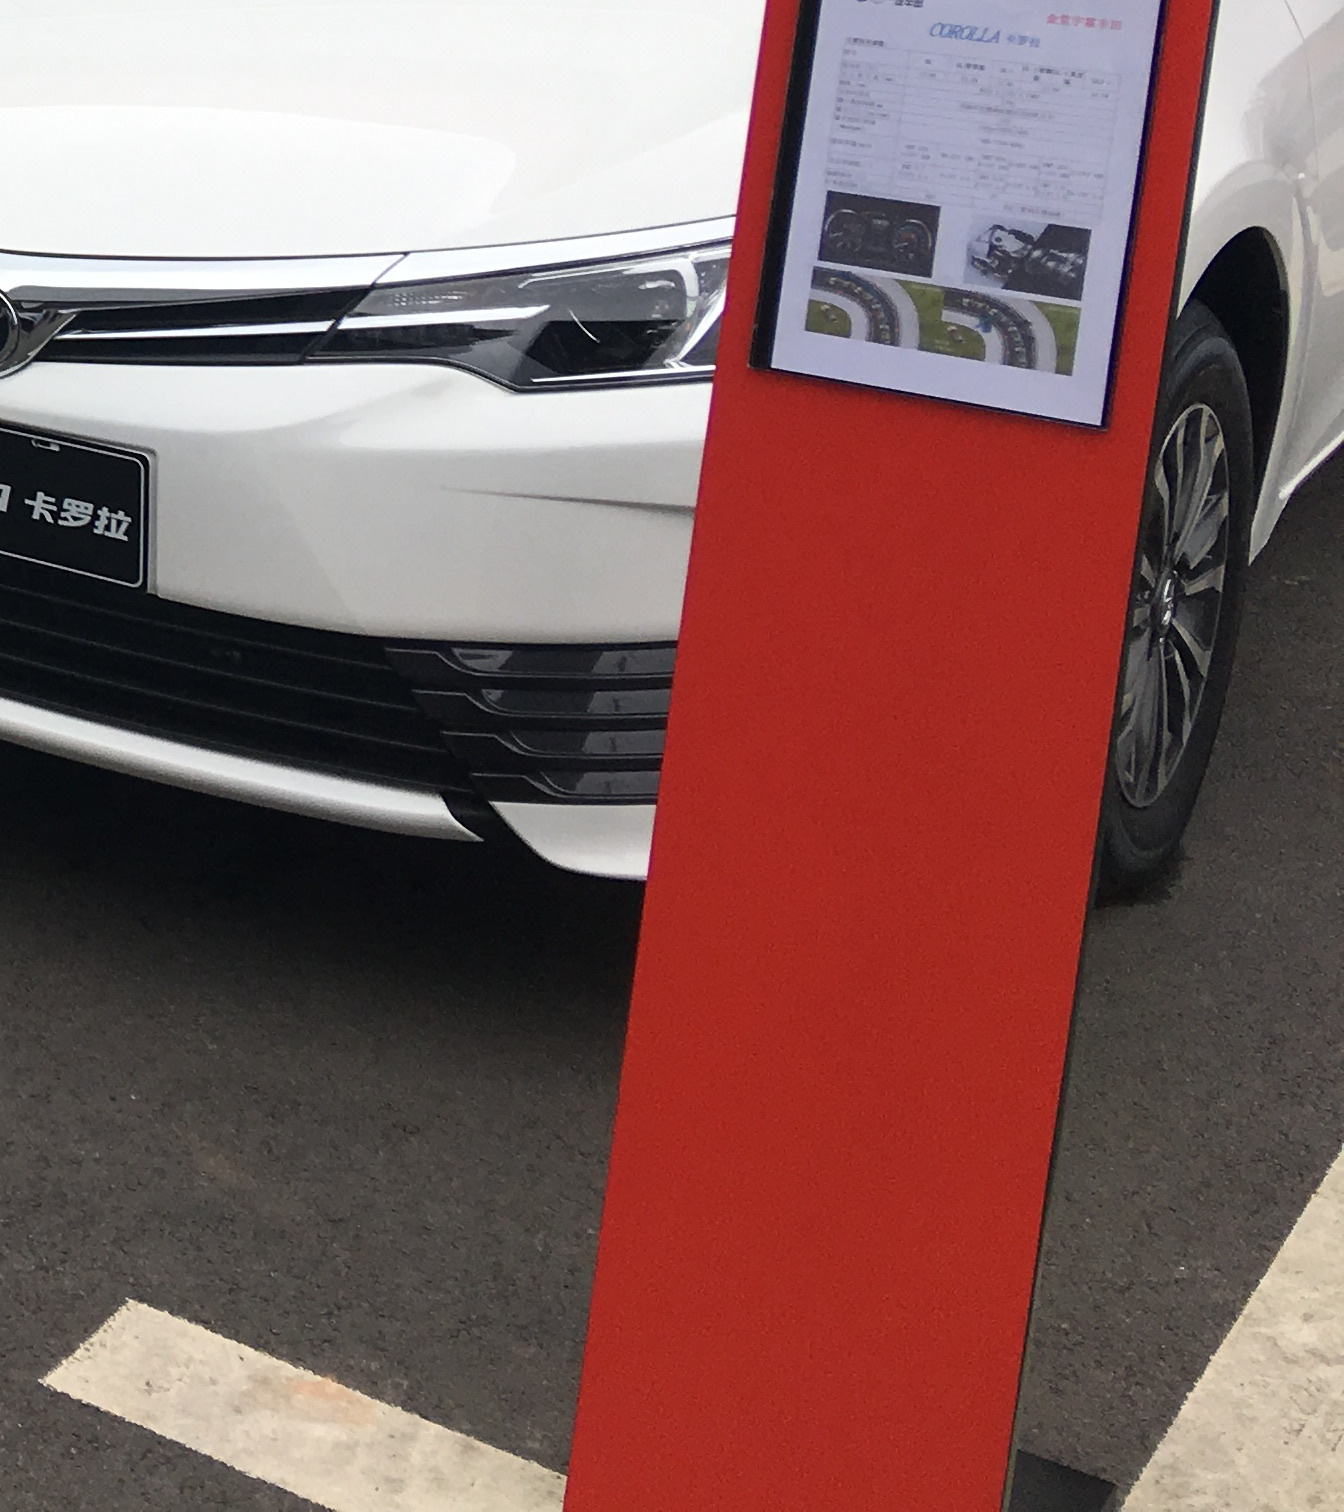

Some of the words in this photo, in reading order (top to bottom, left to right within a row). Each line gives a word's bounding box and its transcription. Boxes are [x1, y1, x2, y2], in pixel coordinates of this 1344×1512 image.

[929, 22, 1001, 44] COROLLA
[24, 490, 133, 542] 卡罗拉
